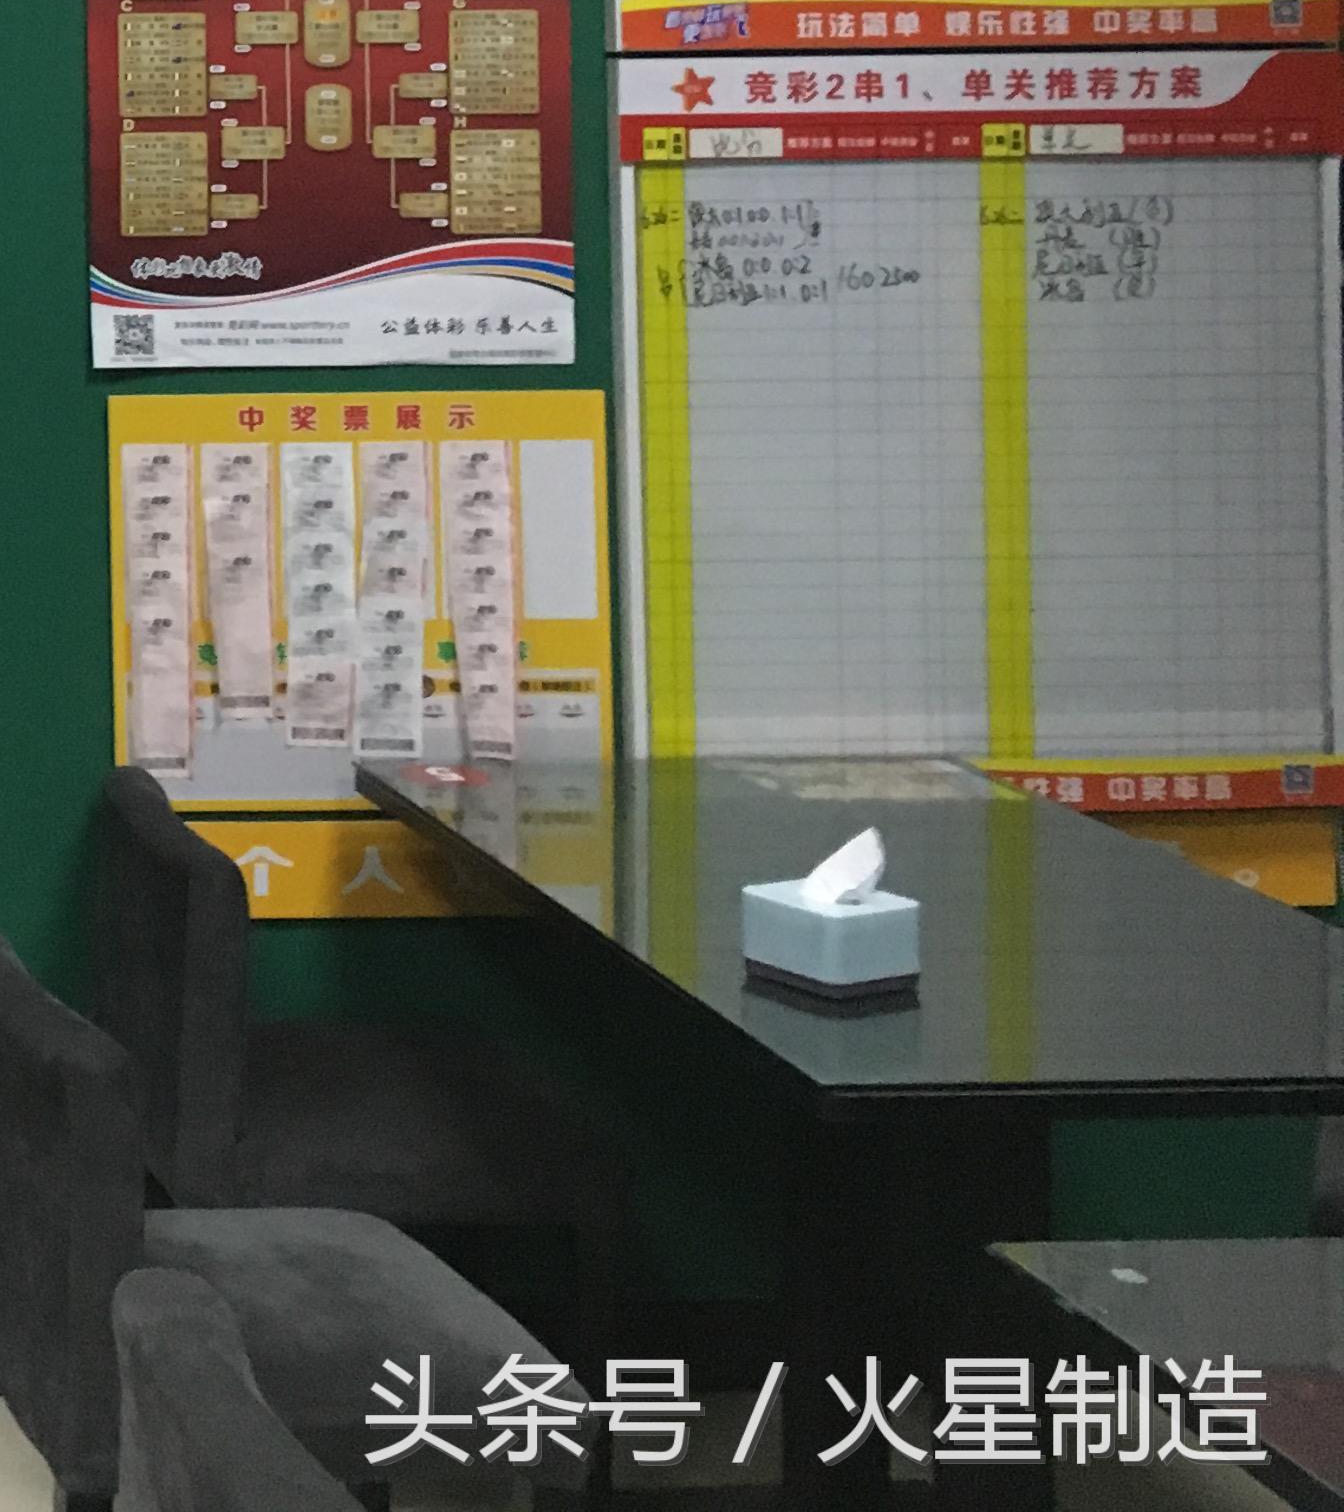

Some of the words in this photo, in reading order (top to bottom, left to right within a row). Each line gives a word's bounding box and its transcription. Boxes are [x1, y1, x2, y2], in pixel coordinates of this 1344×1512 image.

[796, 11, 921, 39] 玩法简单
[744, 65, 1204, 104] 竞彩2串1、单关推荐方案
[237, 404, 477, 433] 中奖票展示
